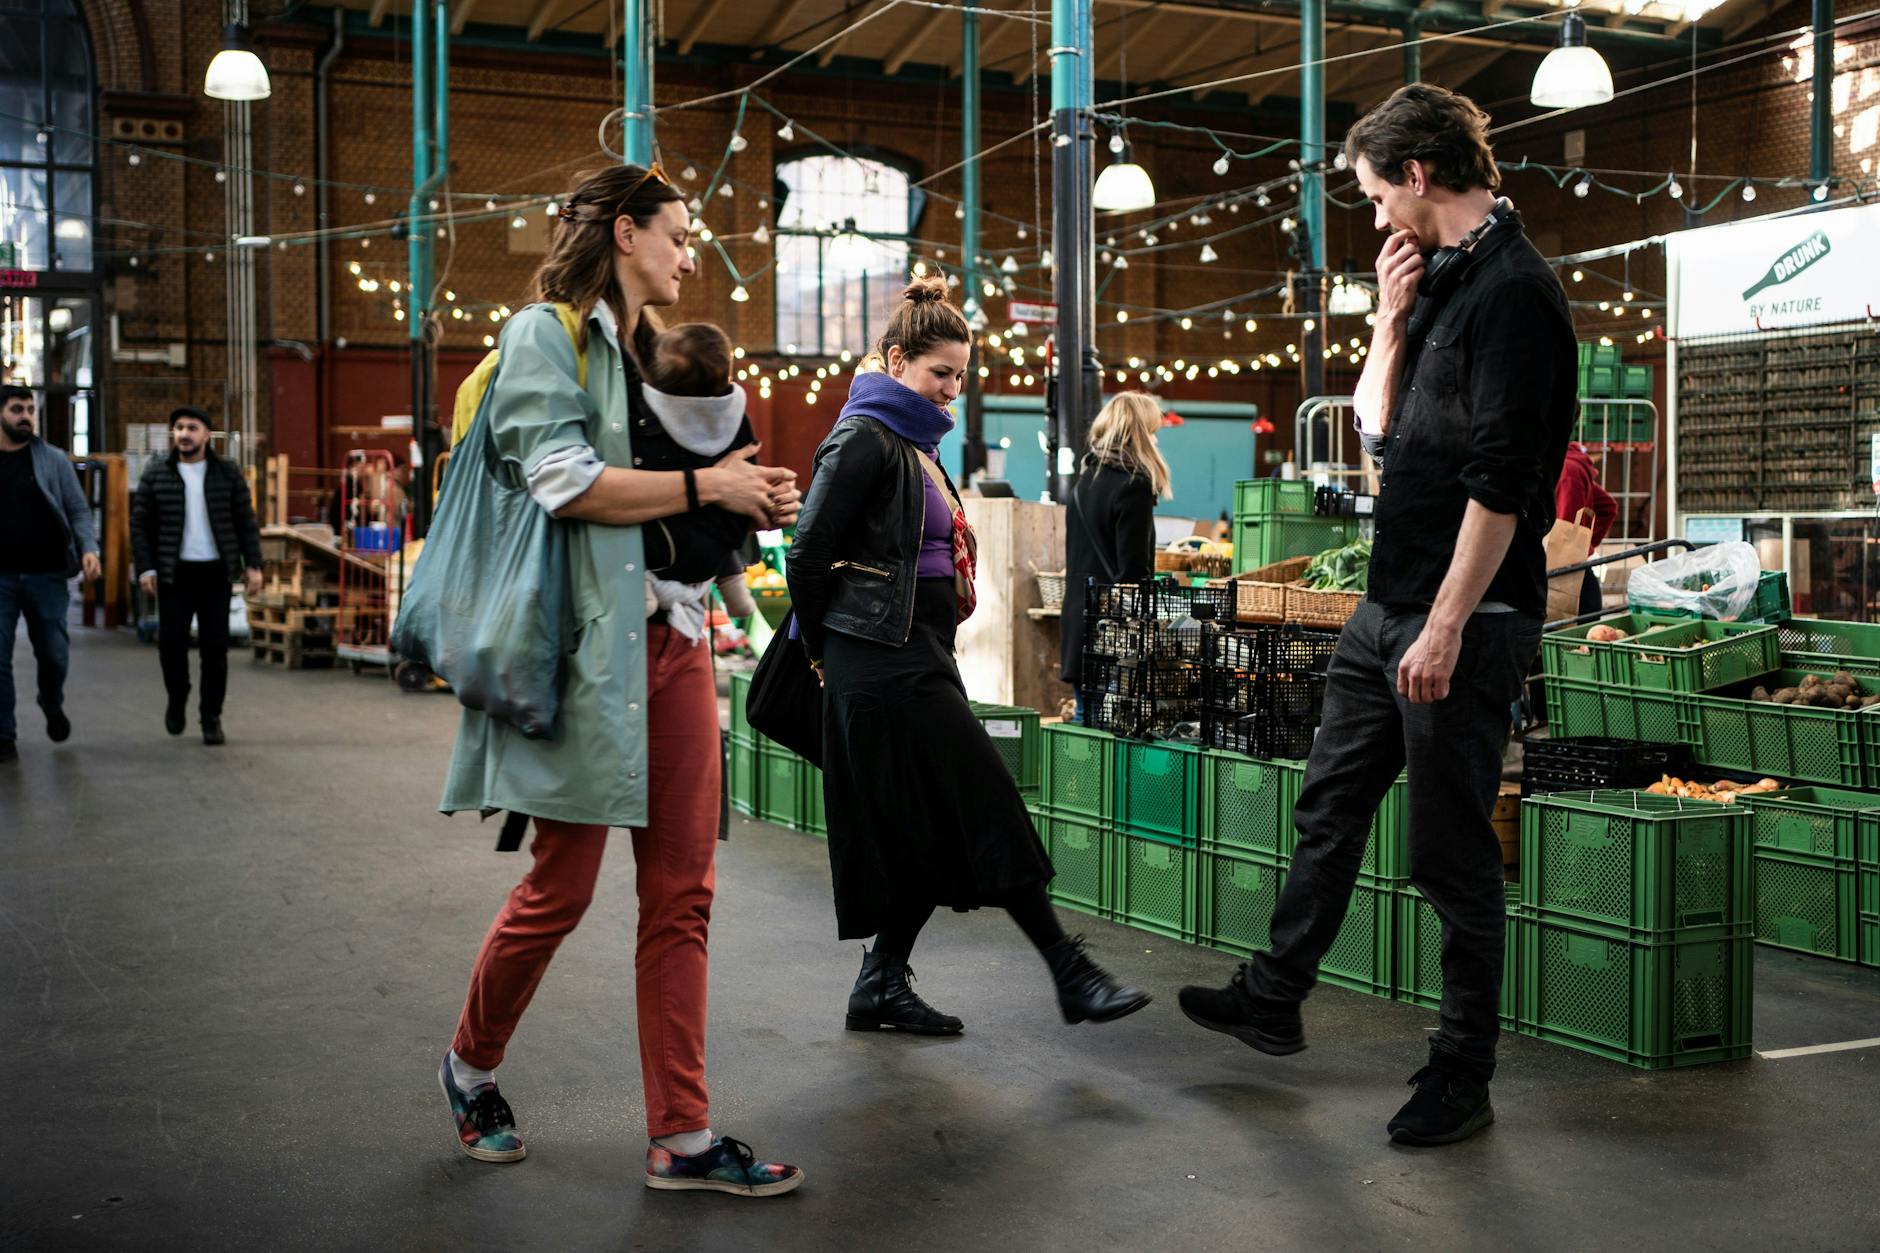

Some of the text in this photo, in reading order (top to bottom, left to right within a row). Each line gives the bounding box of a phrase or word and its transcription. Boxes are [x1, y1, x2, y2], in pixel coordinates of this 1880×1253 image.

[1773, 234, 1827, 282] DRUNK
[1750, 297, 1822, 318] BY NATURE
